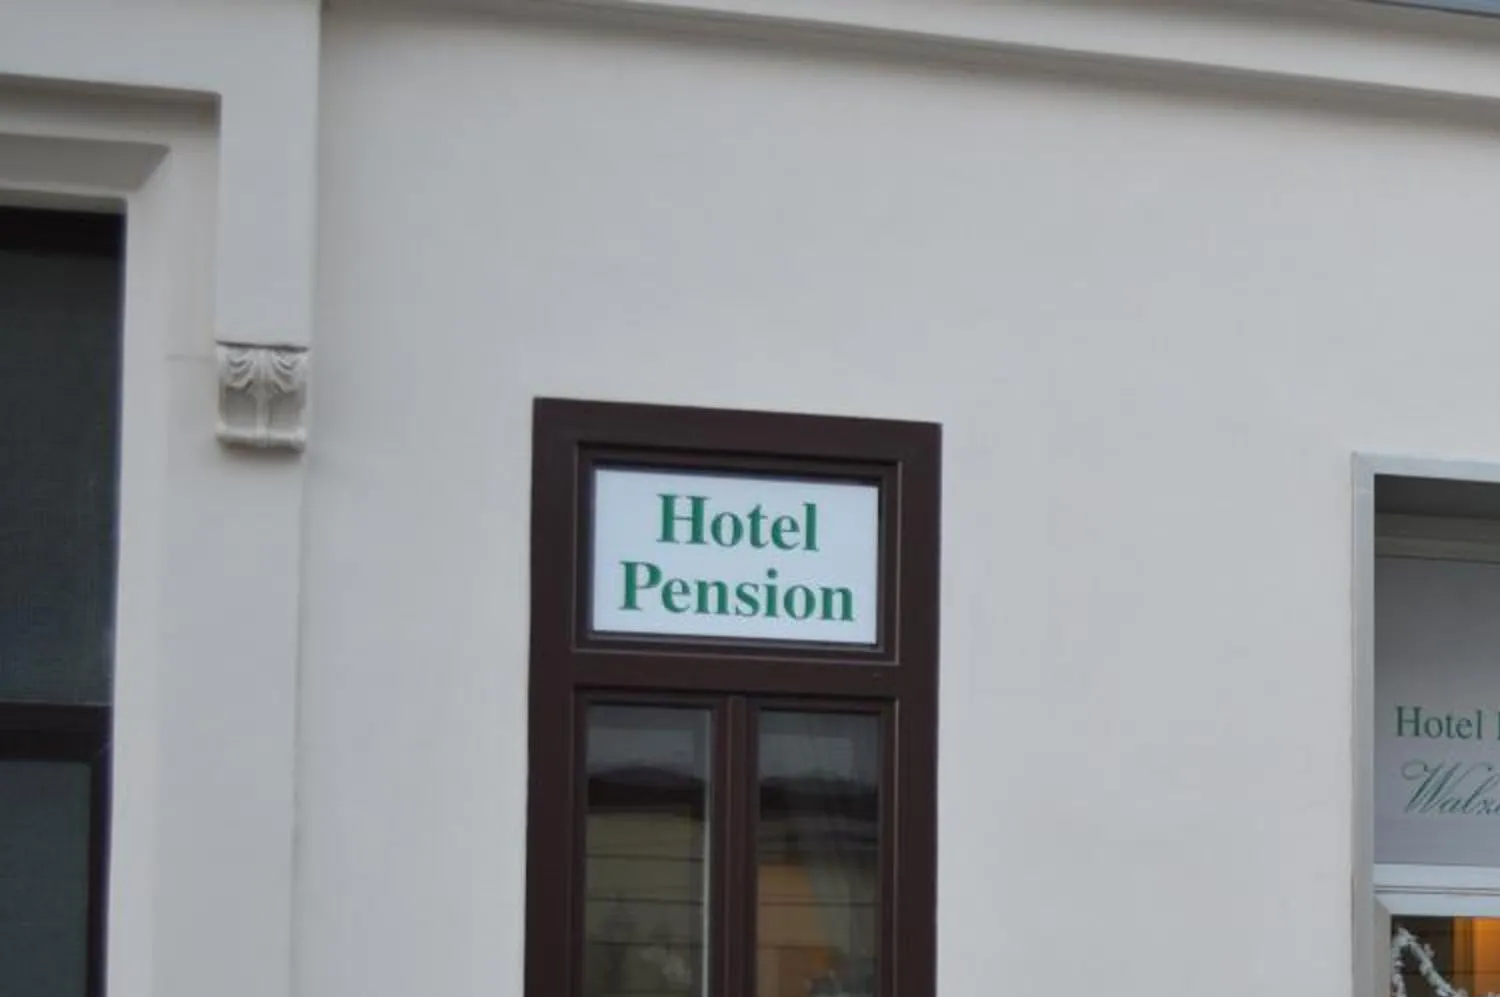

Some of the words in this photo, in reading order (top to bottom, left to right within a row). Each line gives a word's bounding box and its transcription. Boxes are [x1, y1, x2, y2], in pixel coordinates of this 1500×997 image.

[656, 494, 819, 550] Hotel
[618, 560, 854, 621] Pension
[1396, 705, 1484, 740] Hotel
